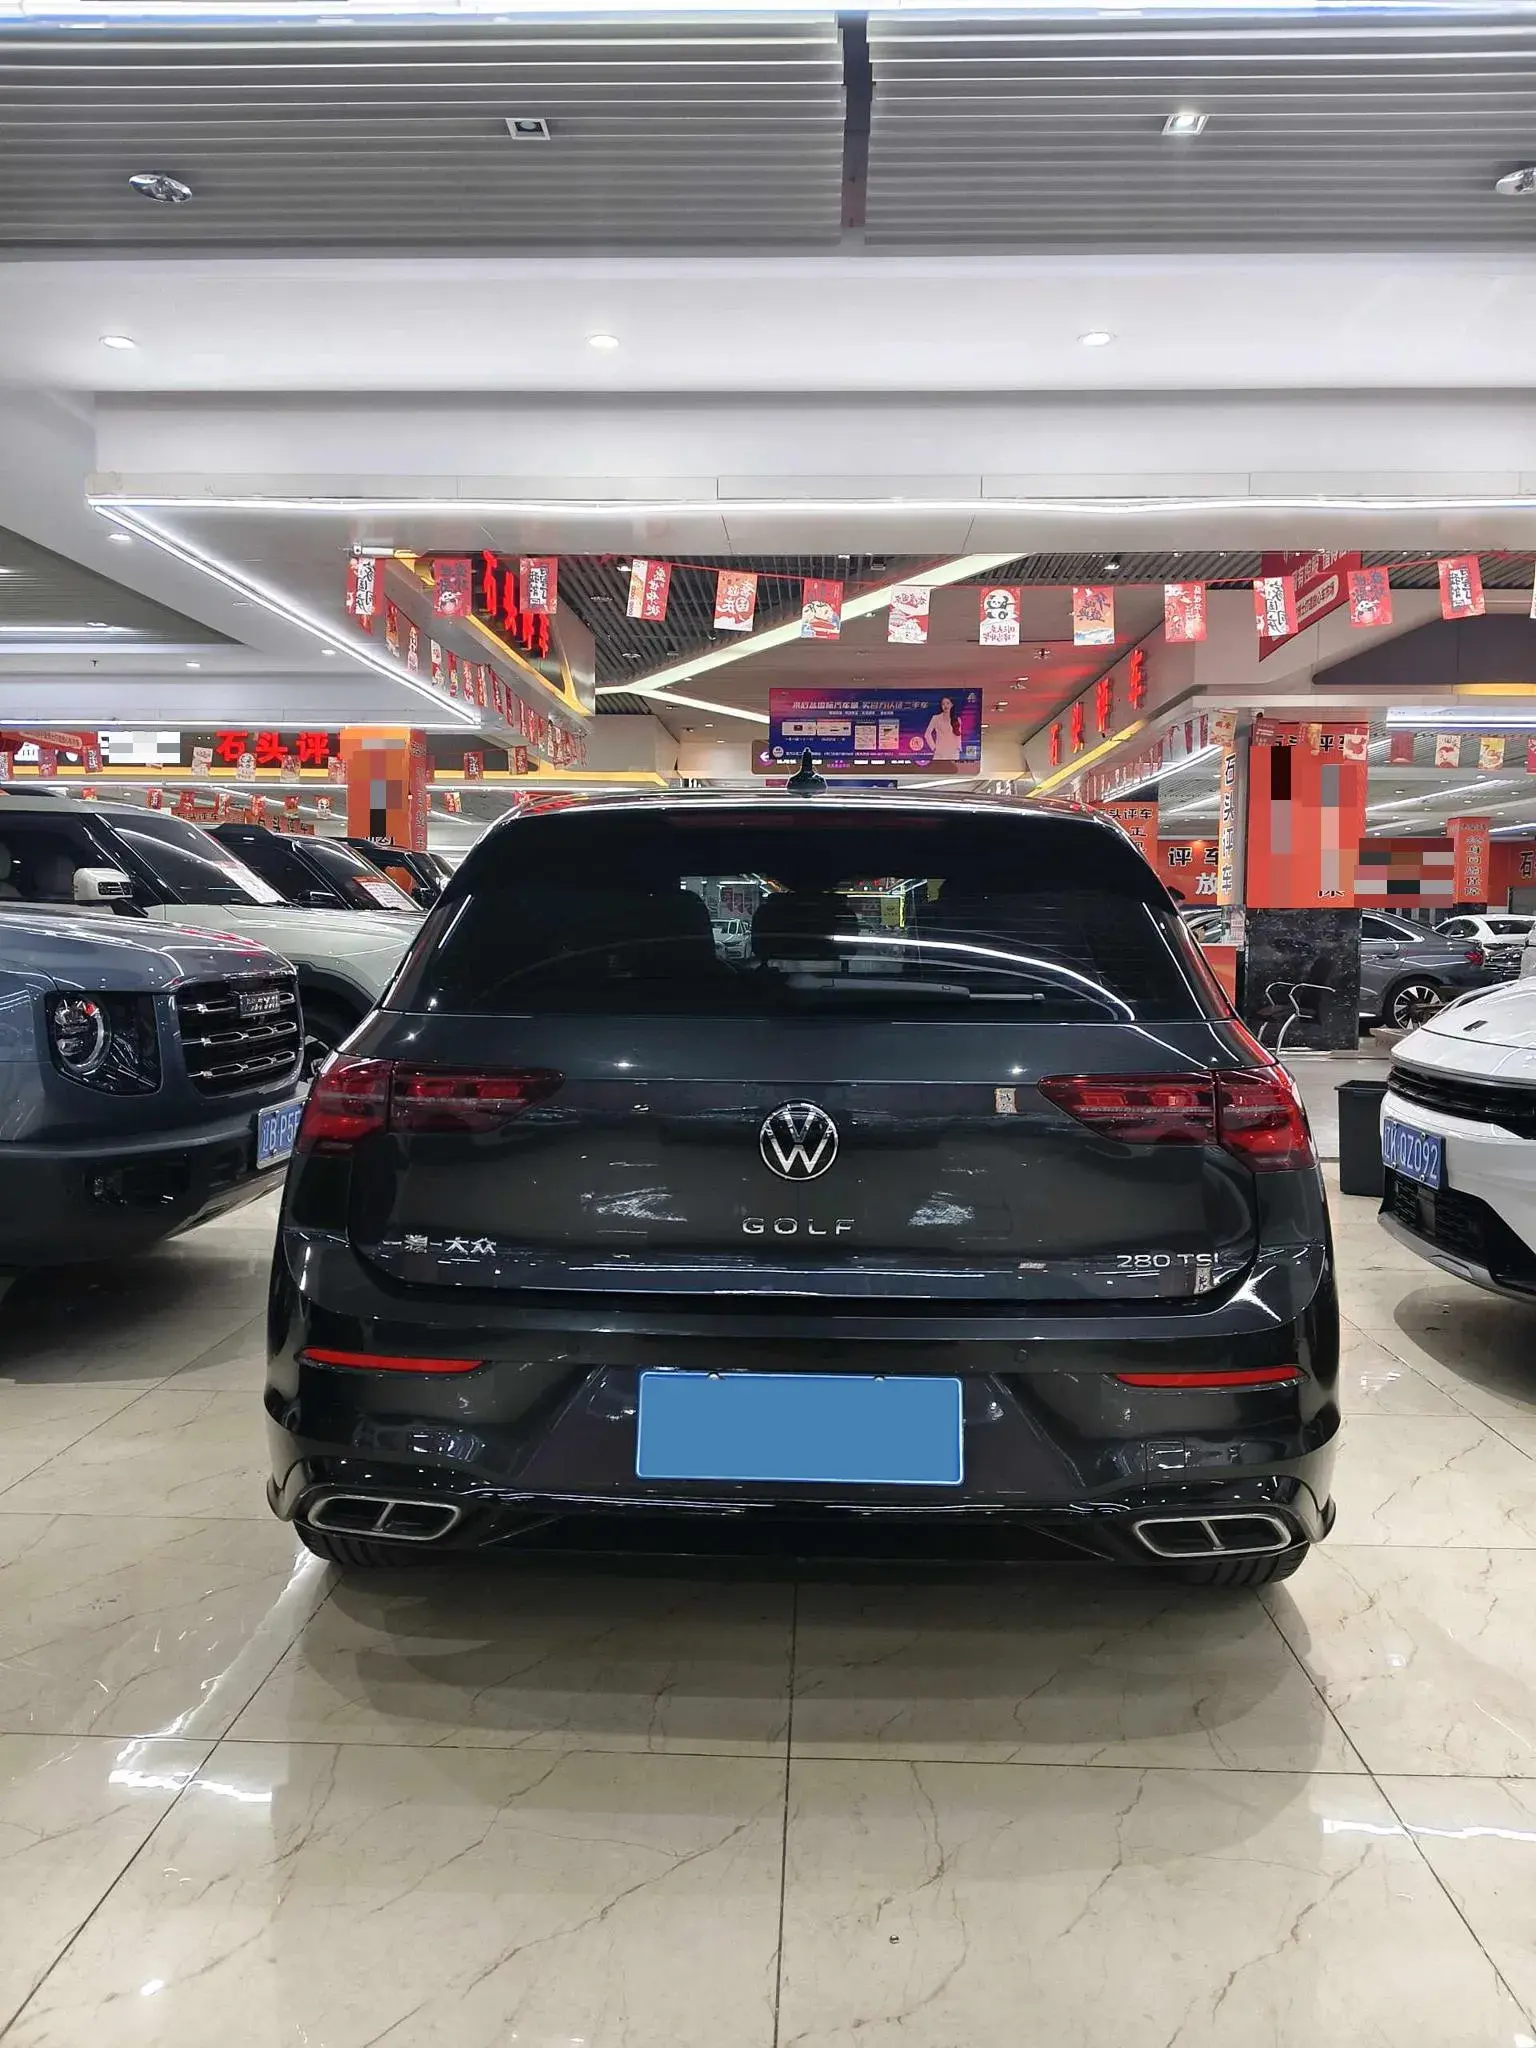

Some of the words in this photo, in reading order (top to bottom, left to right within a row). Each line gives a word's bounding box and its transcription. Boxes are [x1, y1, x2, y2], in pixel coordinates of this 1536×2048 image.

[216, 731, 342, 764] 石头评
[1223, 753, 1237, 895] 石头评车
[742, 1217, 855, 1235] GOLF
[1116, 1254, 1171, 1268] 280
[1177, 1252, 1219, 1267] TSI
